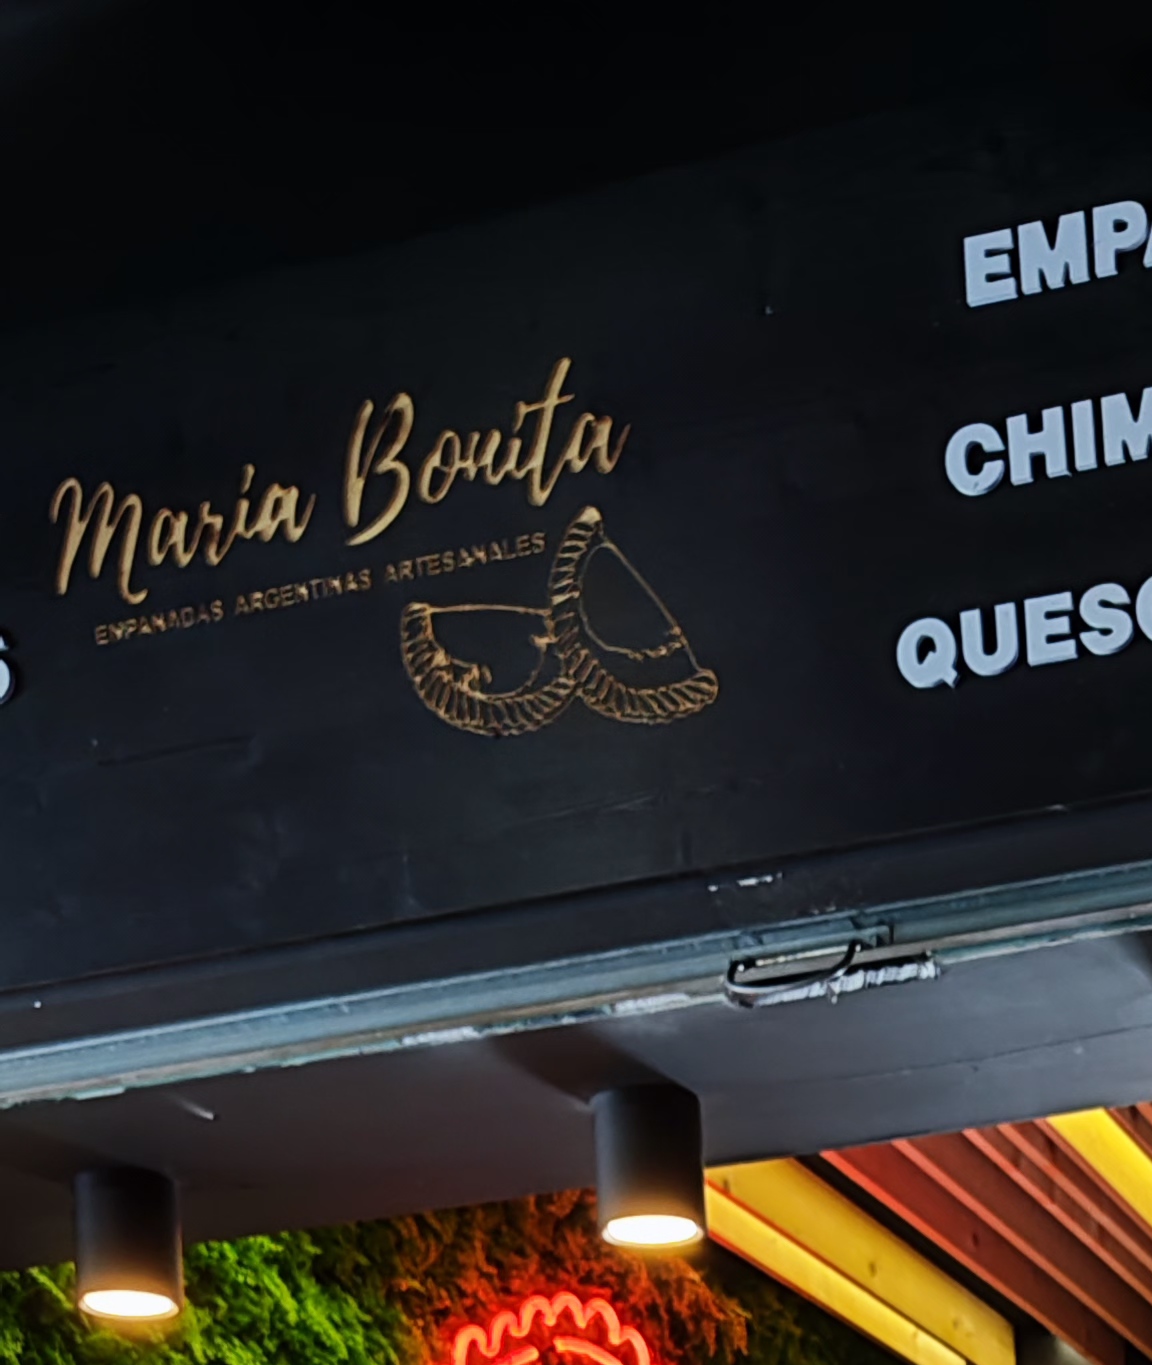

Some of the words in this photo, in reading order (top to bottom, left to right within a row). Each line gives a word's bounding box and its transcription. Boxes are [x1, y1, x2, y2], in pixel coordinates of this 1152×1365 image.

[342, 357, 631, 546] Bonita
[94, 599, 224, 646] EMPANADAS
[233, 568, 372, 616] ARGENTINAS
[384, 531, 547, 583] ARTESANALES
